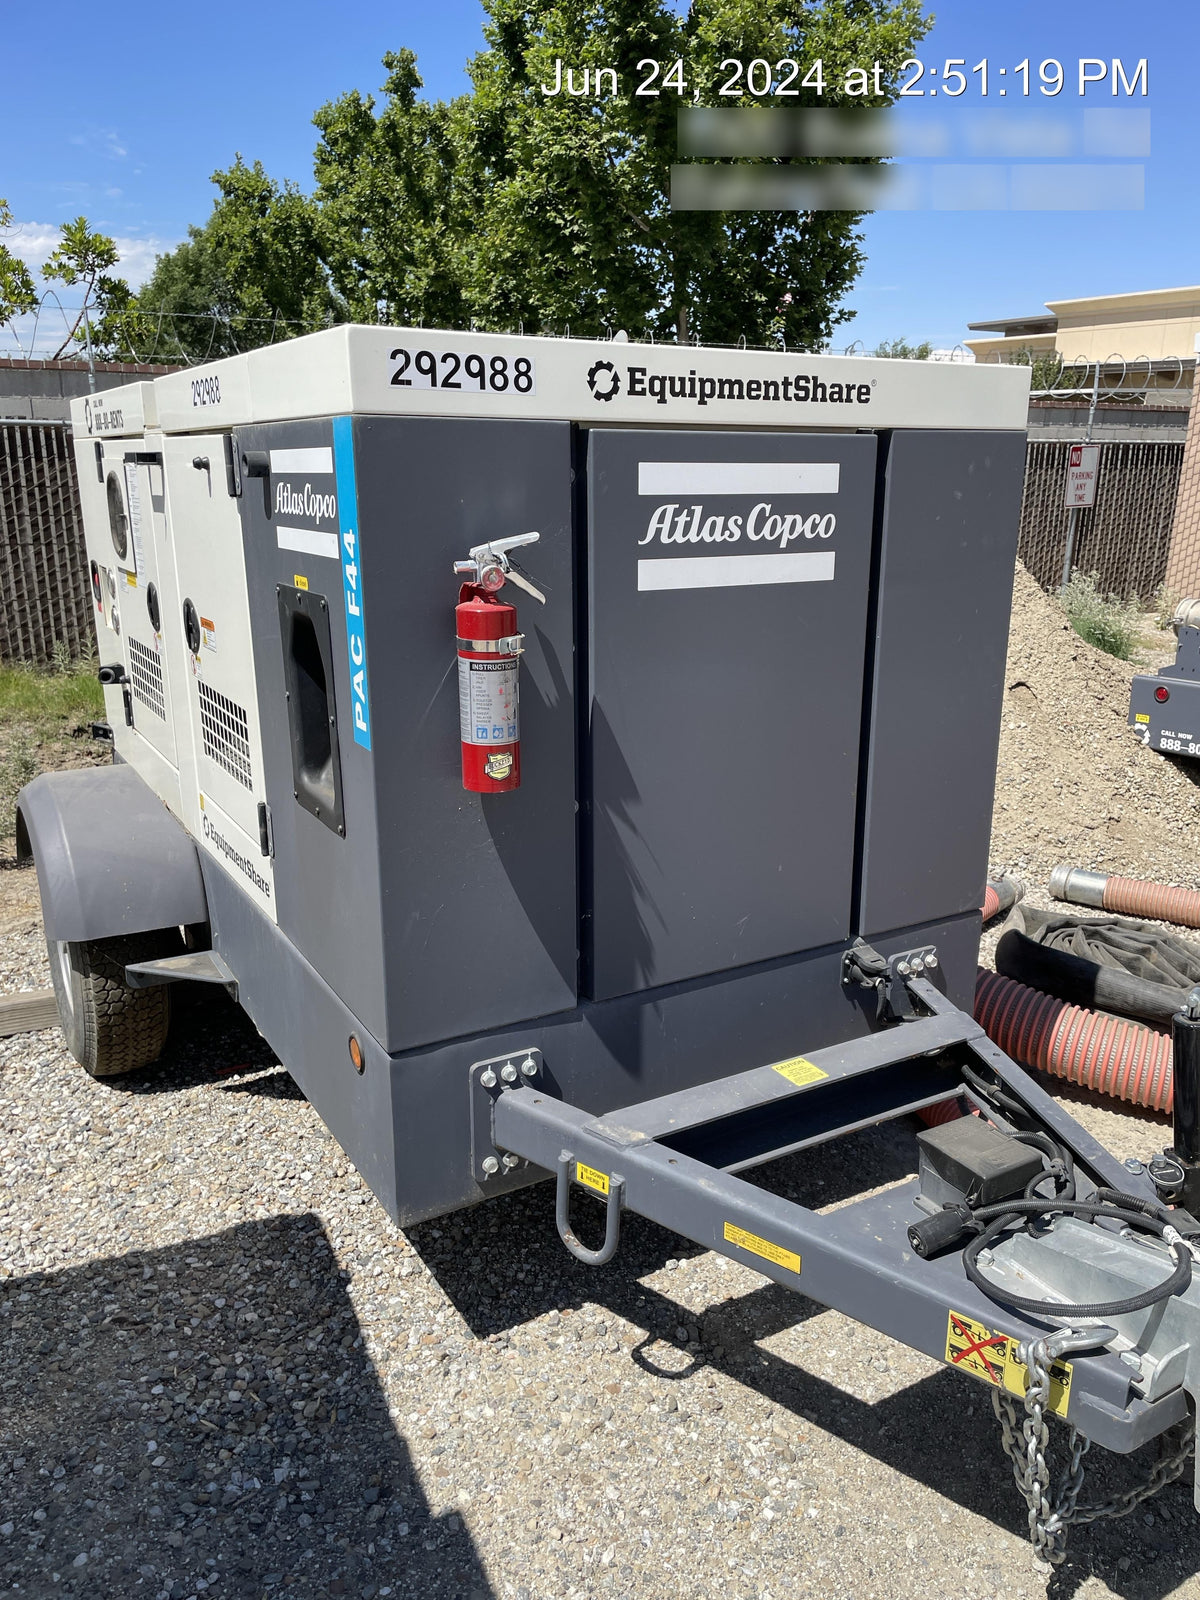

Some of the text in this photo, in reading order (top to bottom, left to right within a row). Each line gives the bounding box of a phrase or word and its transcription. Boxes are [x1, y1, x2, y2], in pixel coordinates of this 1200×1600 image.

[389, 348, 534, 393] 292988
[626, 365, 872, 405] EquipmentShare
[191, 375, 221, 407] 292988
[1070, 450, 1081, 465] NO
[1071, 471, 1094, 481] PARKING
[1075, 482, 1087, 492] ANY
[275, 482, 336, 525] Atlas Copco
[1074, 493, 1086, 503] TIME
[637, 502, 837, 548] Atlas Copco
[343, 529, 367, 733] PAC F44
[471, 661, 517, 671] INSTRUCTIONS
[1160, 729, 1193, 741] CALL NOW
[210, 821, 271, 898] EquipmentShare
